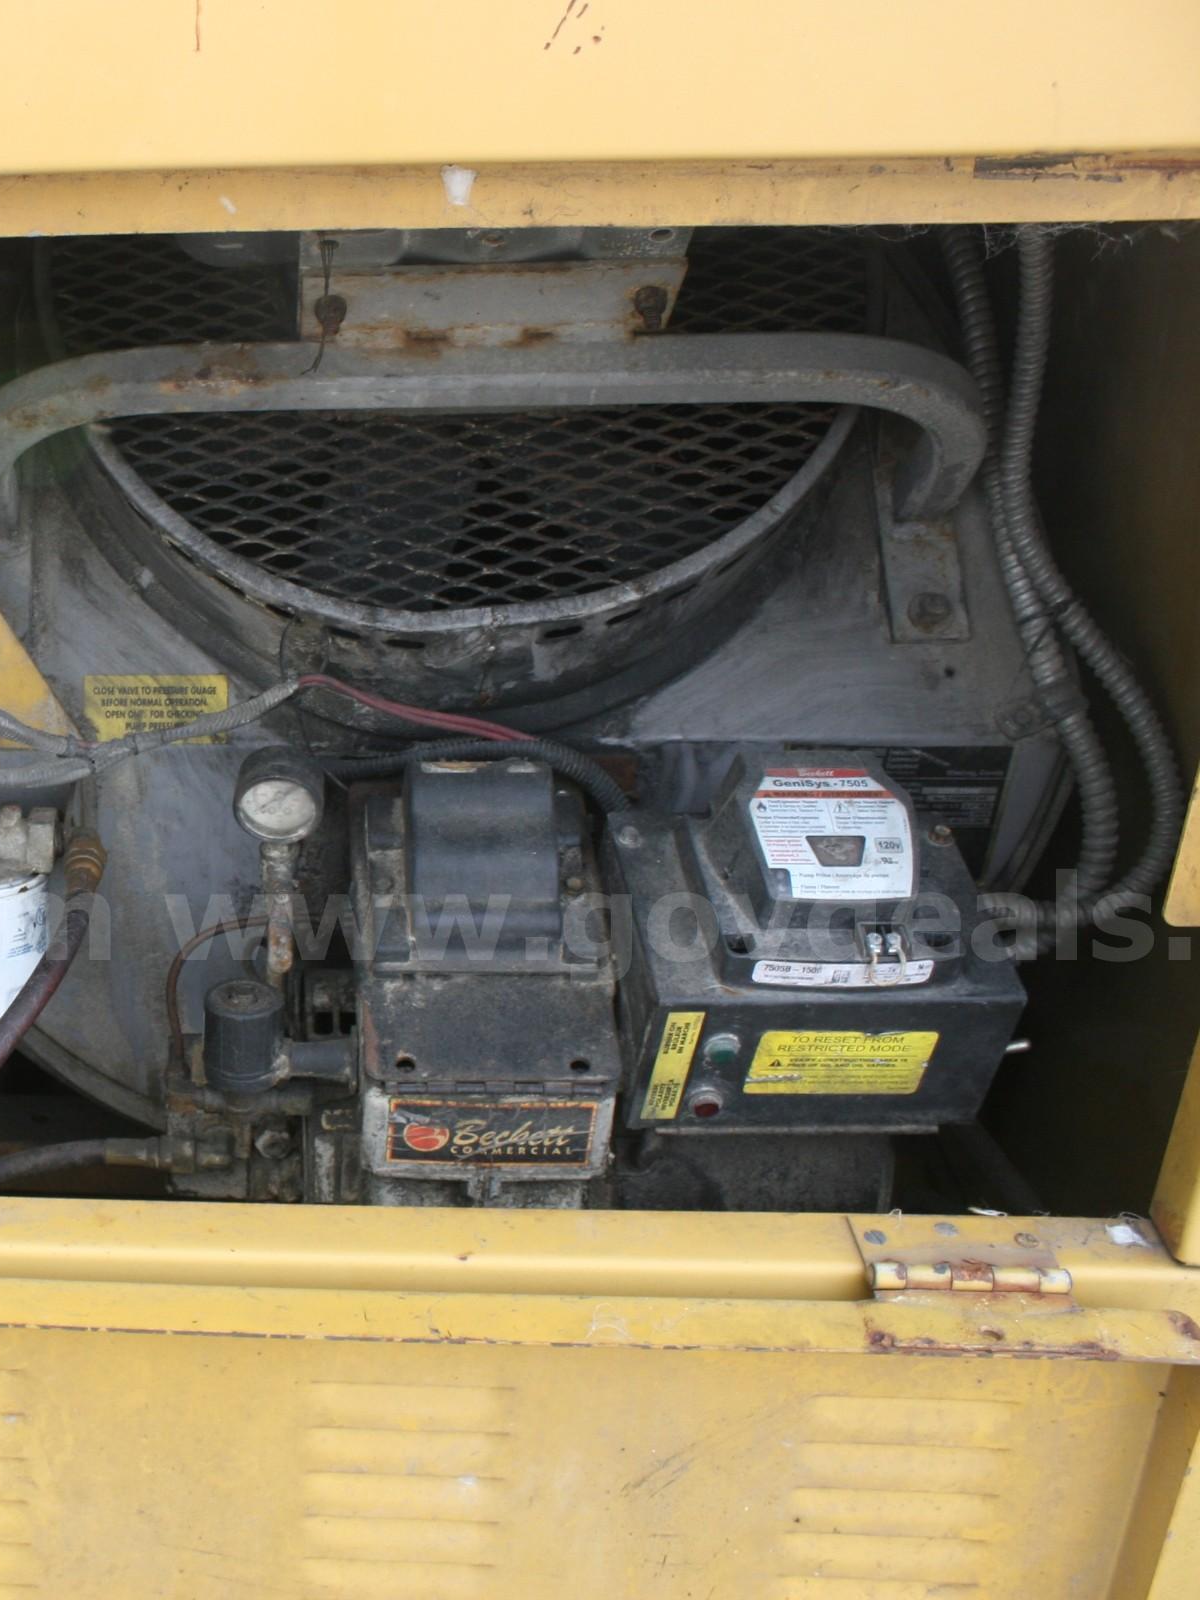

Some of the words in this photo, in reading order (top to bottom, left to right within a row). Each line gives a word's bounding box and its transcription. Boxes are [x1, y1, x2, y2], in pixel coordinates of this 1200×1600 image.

[791, 1036, 810, 1044] TO
[813, 1036, 860, 1044] RESET
[863, 1036, 905, 1044] FROM
[777, 1044, 866, 1053] RESTRICTED
[868, 1044, 912, 1053] MODE
[452, 1119, 575, 1147] Beckett
